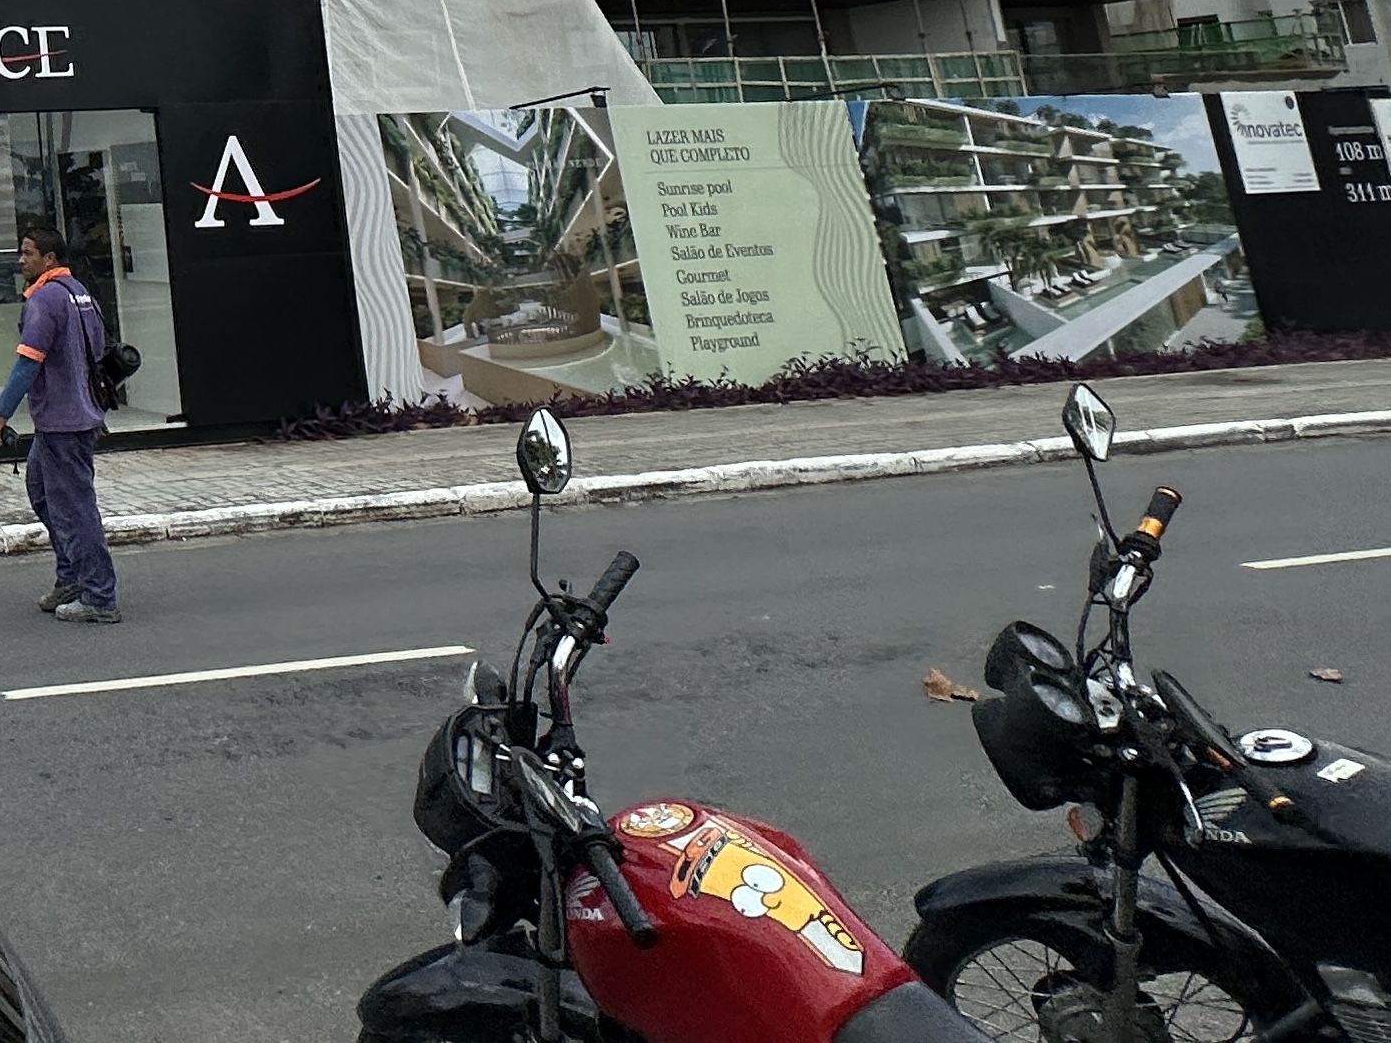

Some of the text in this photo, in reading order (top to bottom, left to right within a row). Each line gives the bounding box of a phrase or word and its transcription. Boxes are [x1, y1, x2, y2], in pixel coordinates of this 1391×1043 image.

[646, 129, 725, 145] LAZER MAIS
[650, 146, 750, 165] QUE COMPLETO
[1335, 141, 1365, 161] 108
[194, 135, 285, 228] A
[657, 179, 733, 197] Sunrise pool
[1344, 182, 1376, 203] 311
[661, 202, 718, 217] Pool Kids
[665, 223, 721, 238] Wine Bar
[671, 243, 774, 261] Salão de Eventos
[676, 269, 731, 284] Gourmet
[681, 288, 770, 307] Salão de Jogos
[685, 311, 774, 329] Brinquedoteca
[690, 332, 760, 353] Playground
[1205, 829, 1253, 845] NDA
